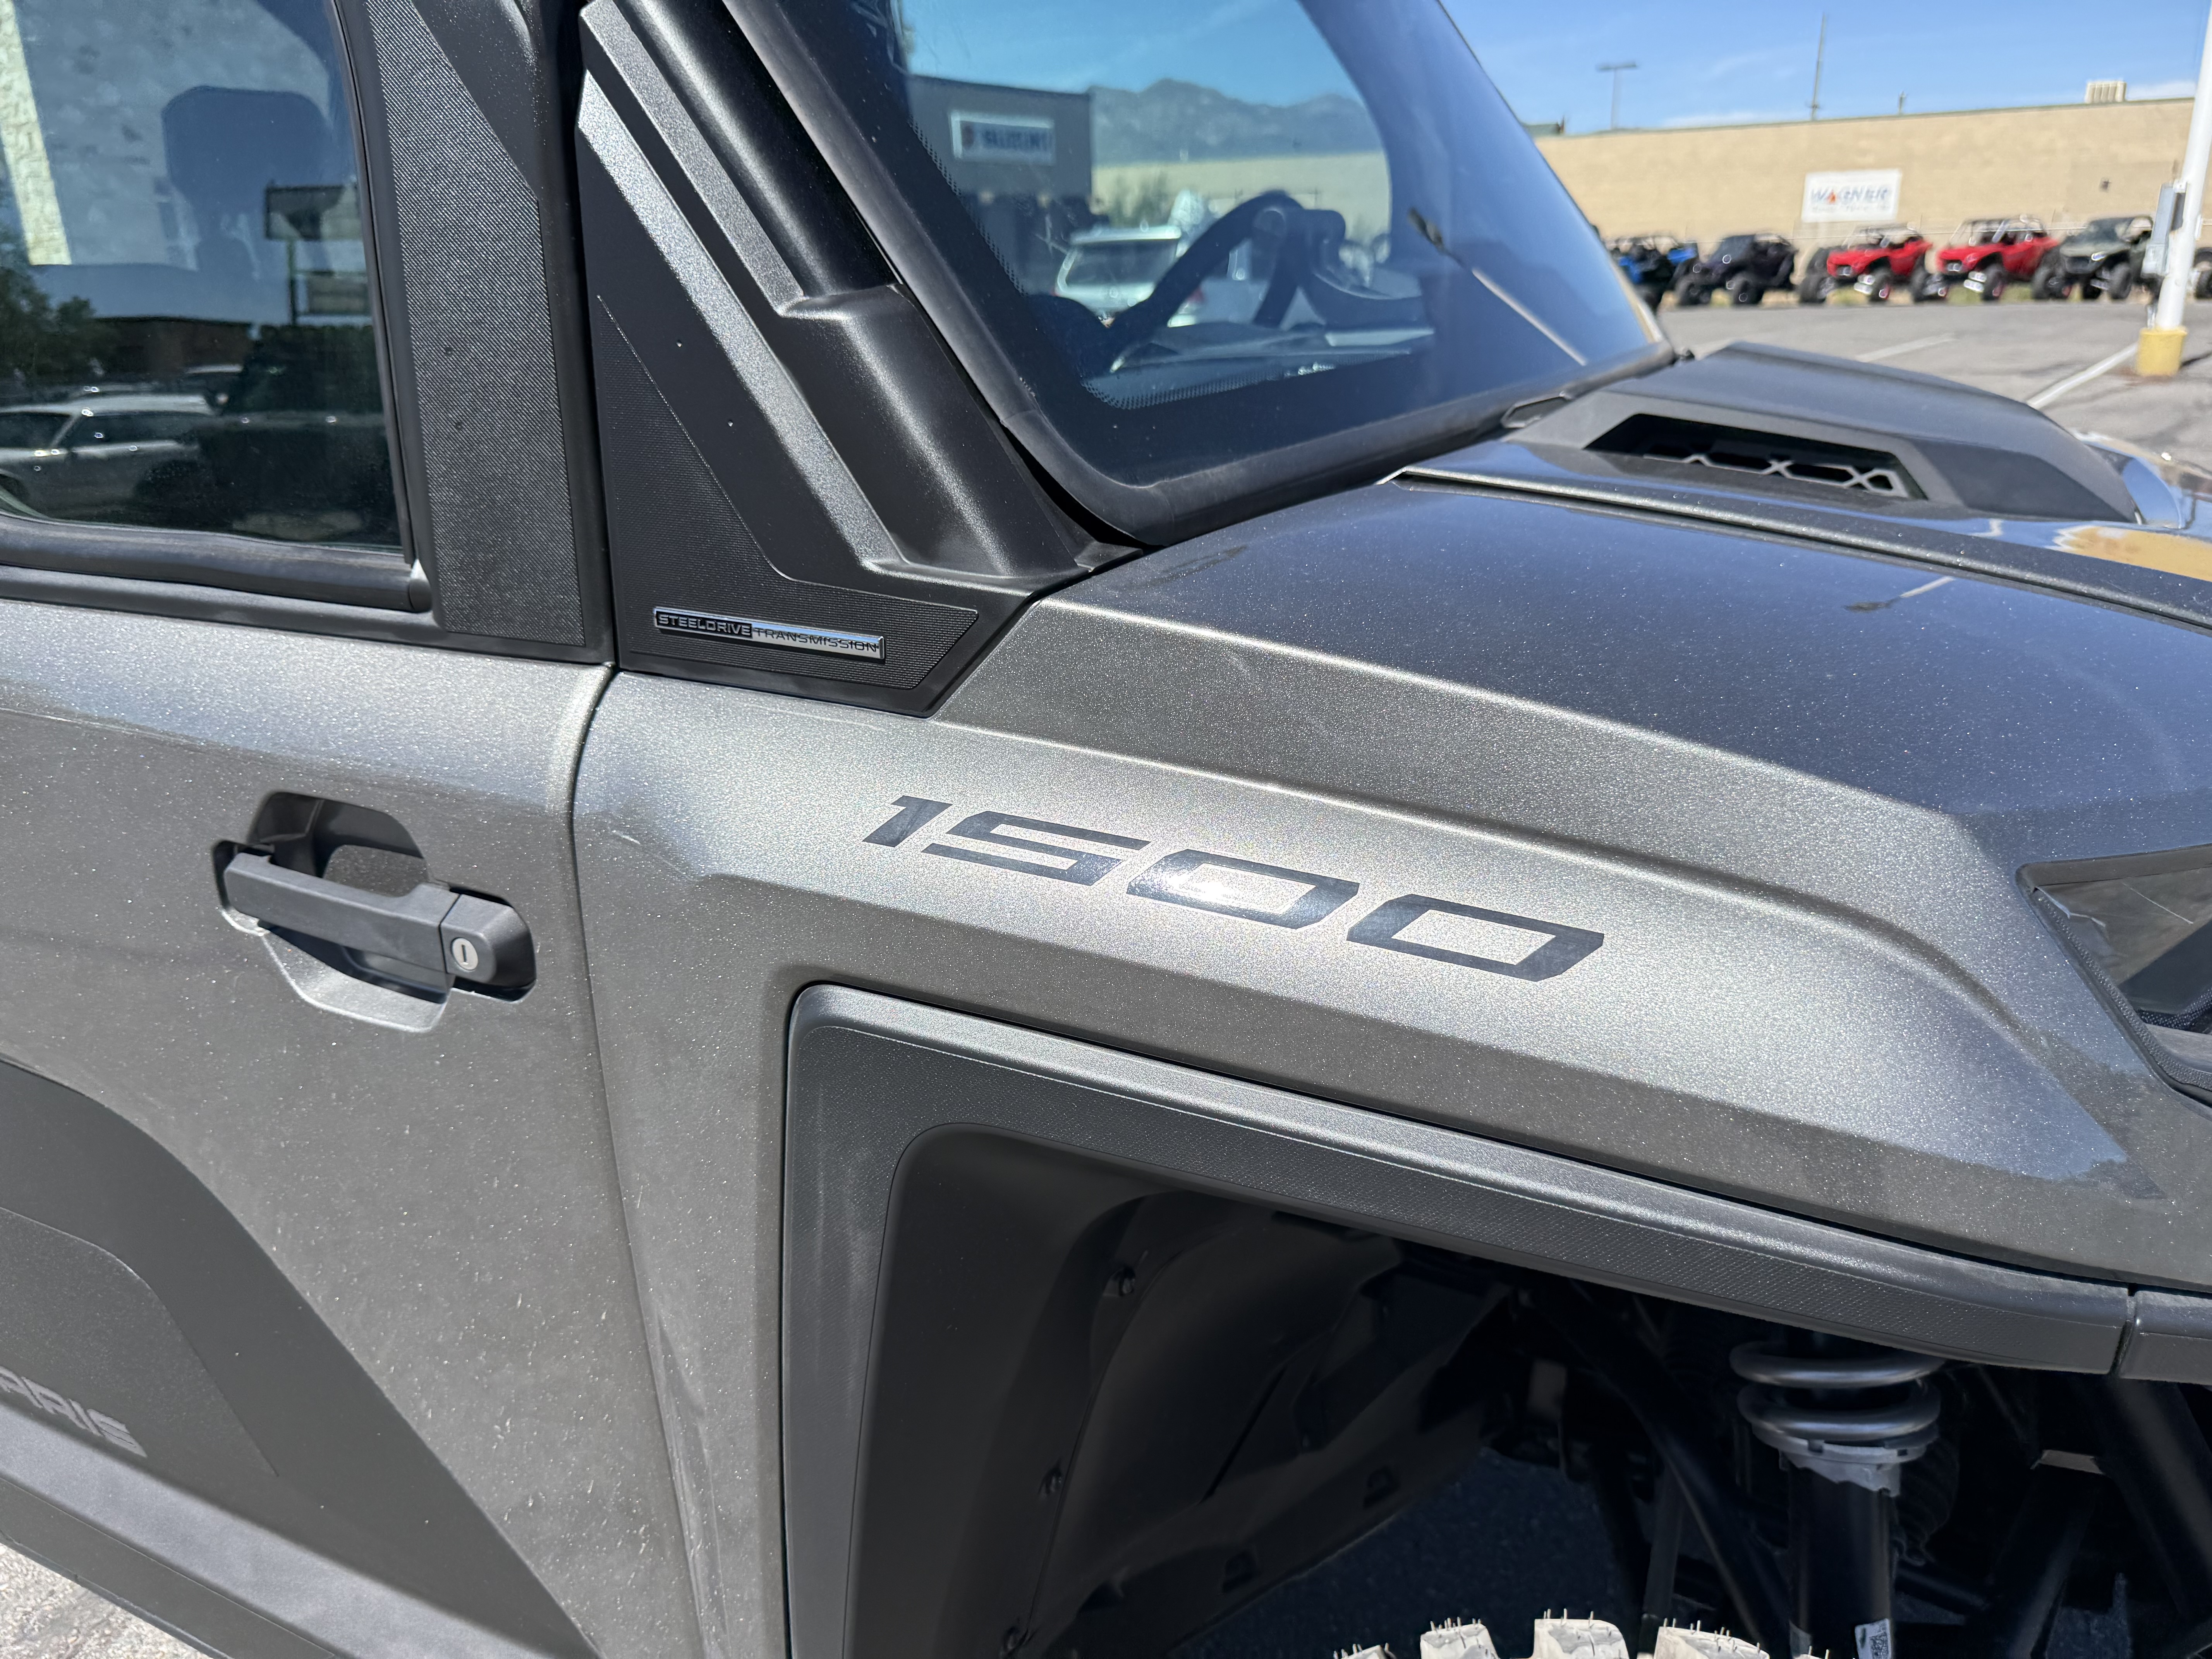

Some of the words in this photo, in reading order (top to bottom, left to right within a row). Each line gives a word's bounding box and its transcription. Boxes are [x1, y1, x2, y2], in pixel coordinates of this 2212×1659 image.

[659, 614, 751, 636] STEELDRIVE
[754, 627, 878, 653] TRANSMISSION
[863, 795, 1604, 982] 1500
